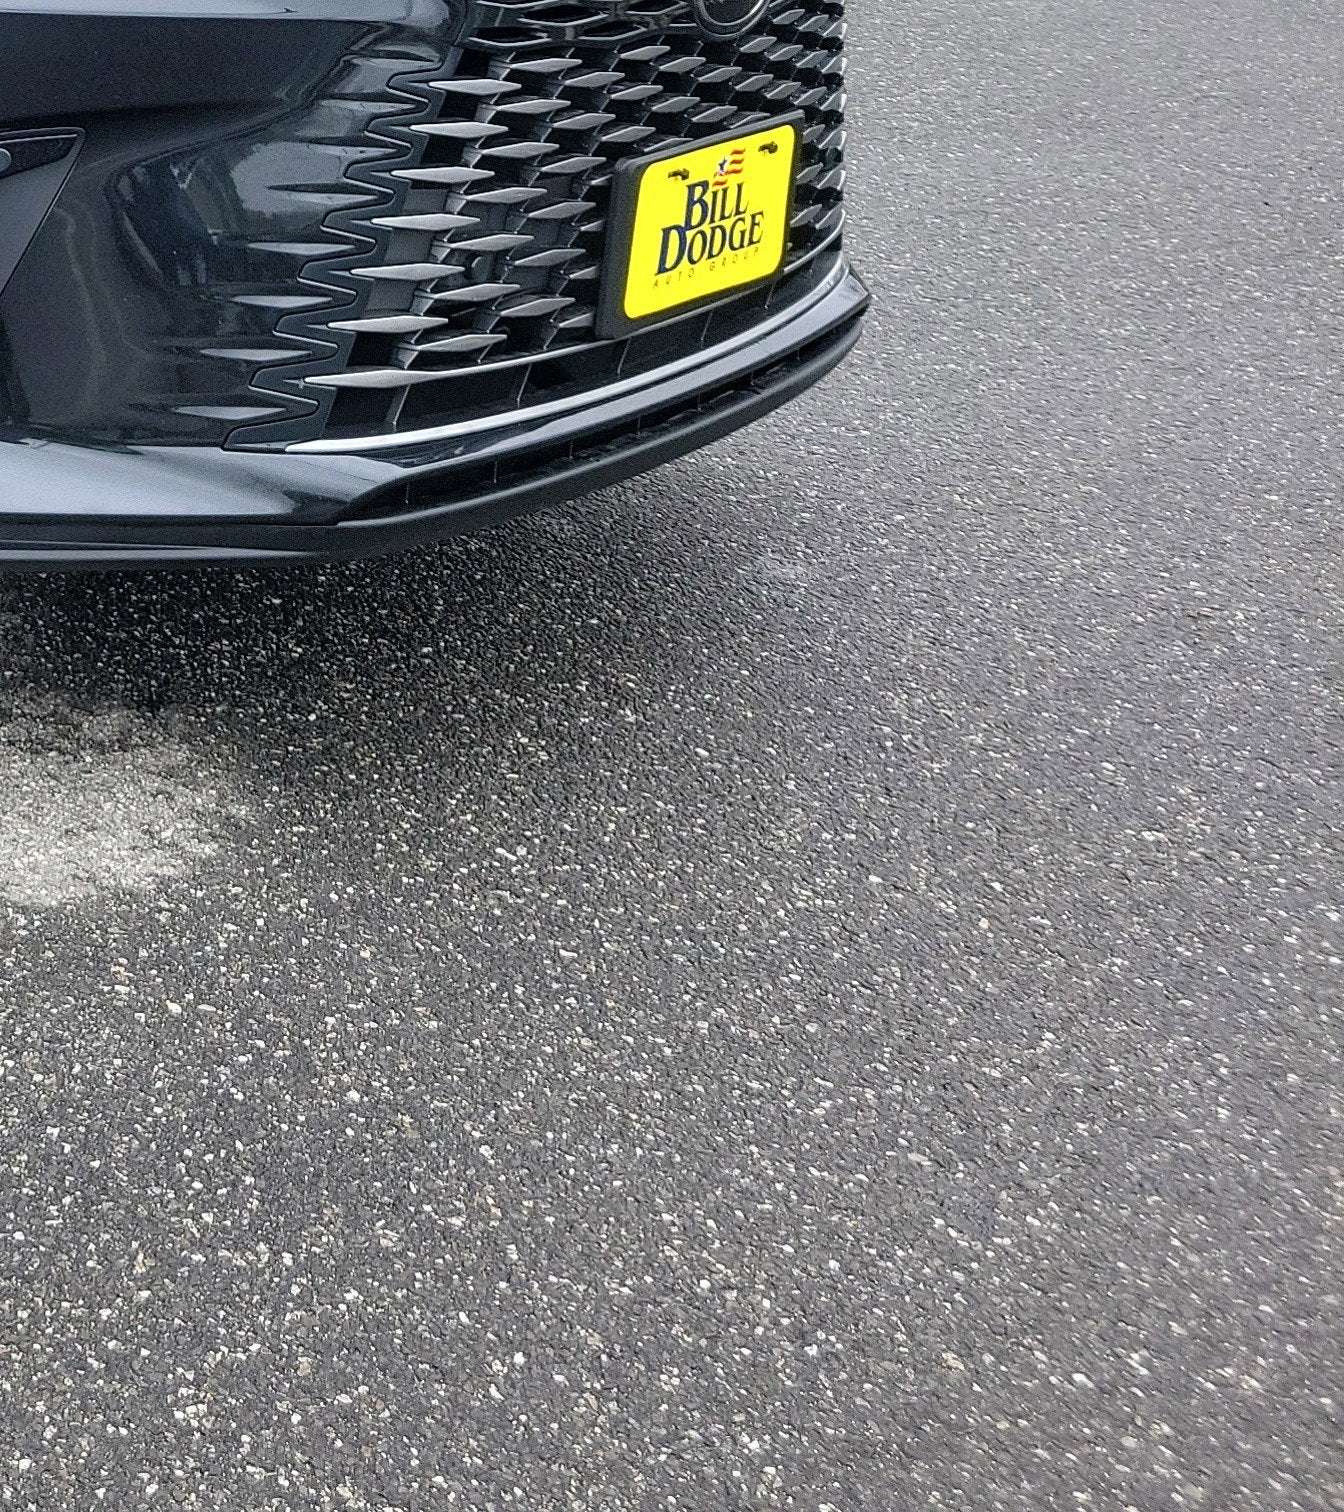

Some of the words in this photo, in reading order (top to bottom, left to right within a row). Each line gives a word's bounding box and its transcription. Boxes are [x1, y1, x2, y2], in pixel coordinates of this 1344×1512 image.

[683, 179, 750, 232] BILL
[652, 267, 696, 289] AUTO
[709, 246, 760, 273] GROUP
[654, 210, 765, 277] DODGE
